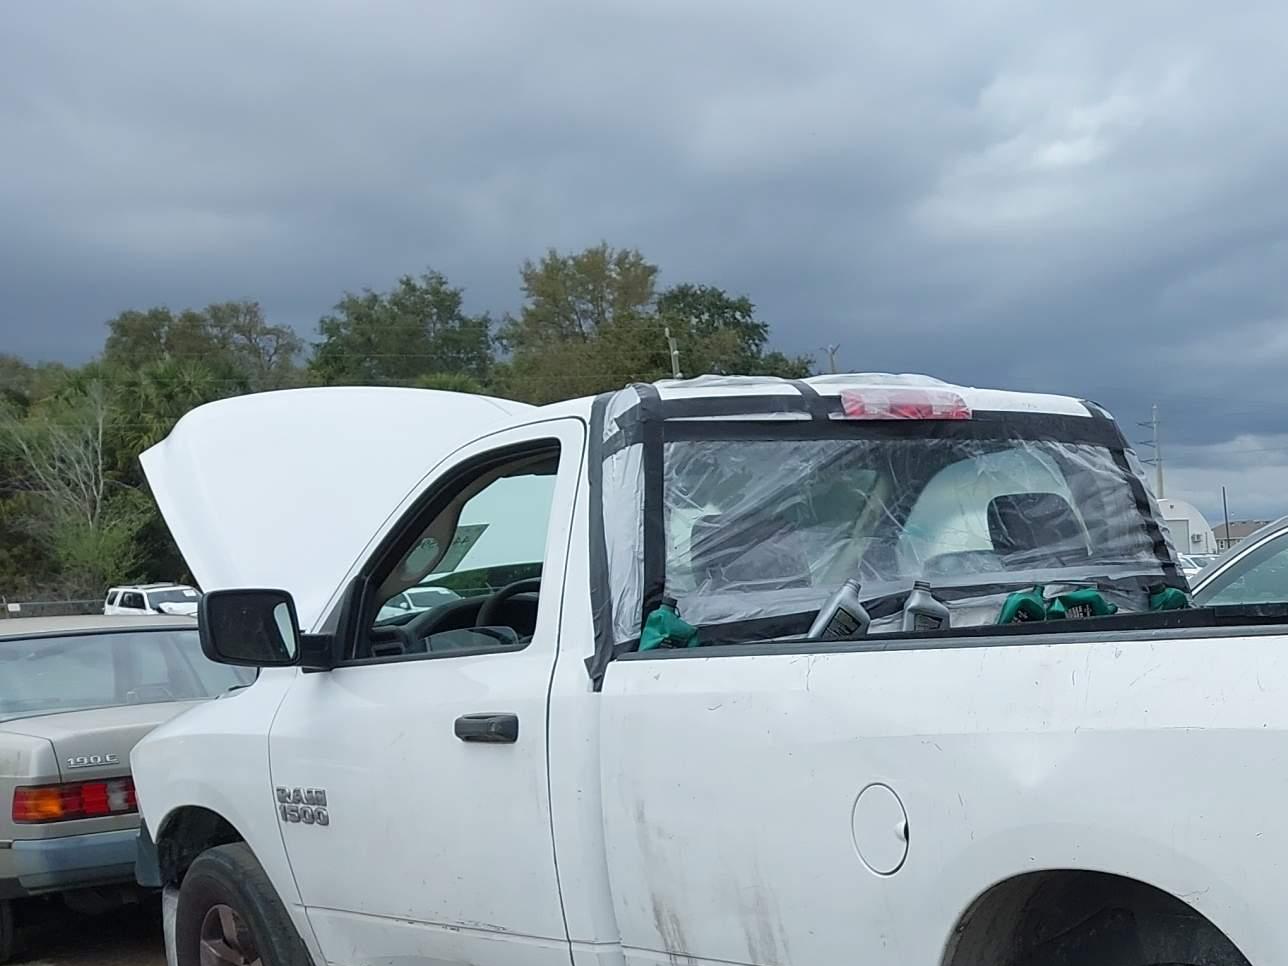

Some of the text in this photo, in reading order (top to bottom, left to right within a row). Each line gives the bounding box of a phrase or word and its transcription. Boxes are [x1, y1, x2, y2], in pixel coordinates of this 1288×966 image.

[67, 753, 119, 766] 190 E
[276, 787, 328, 806] RAM
[279, 804, 330, 826] 1500
